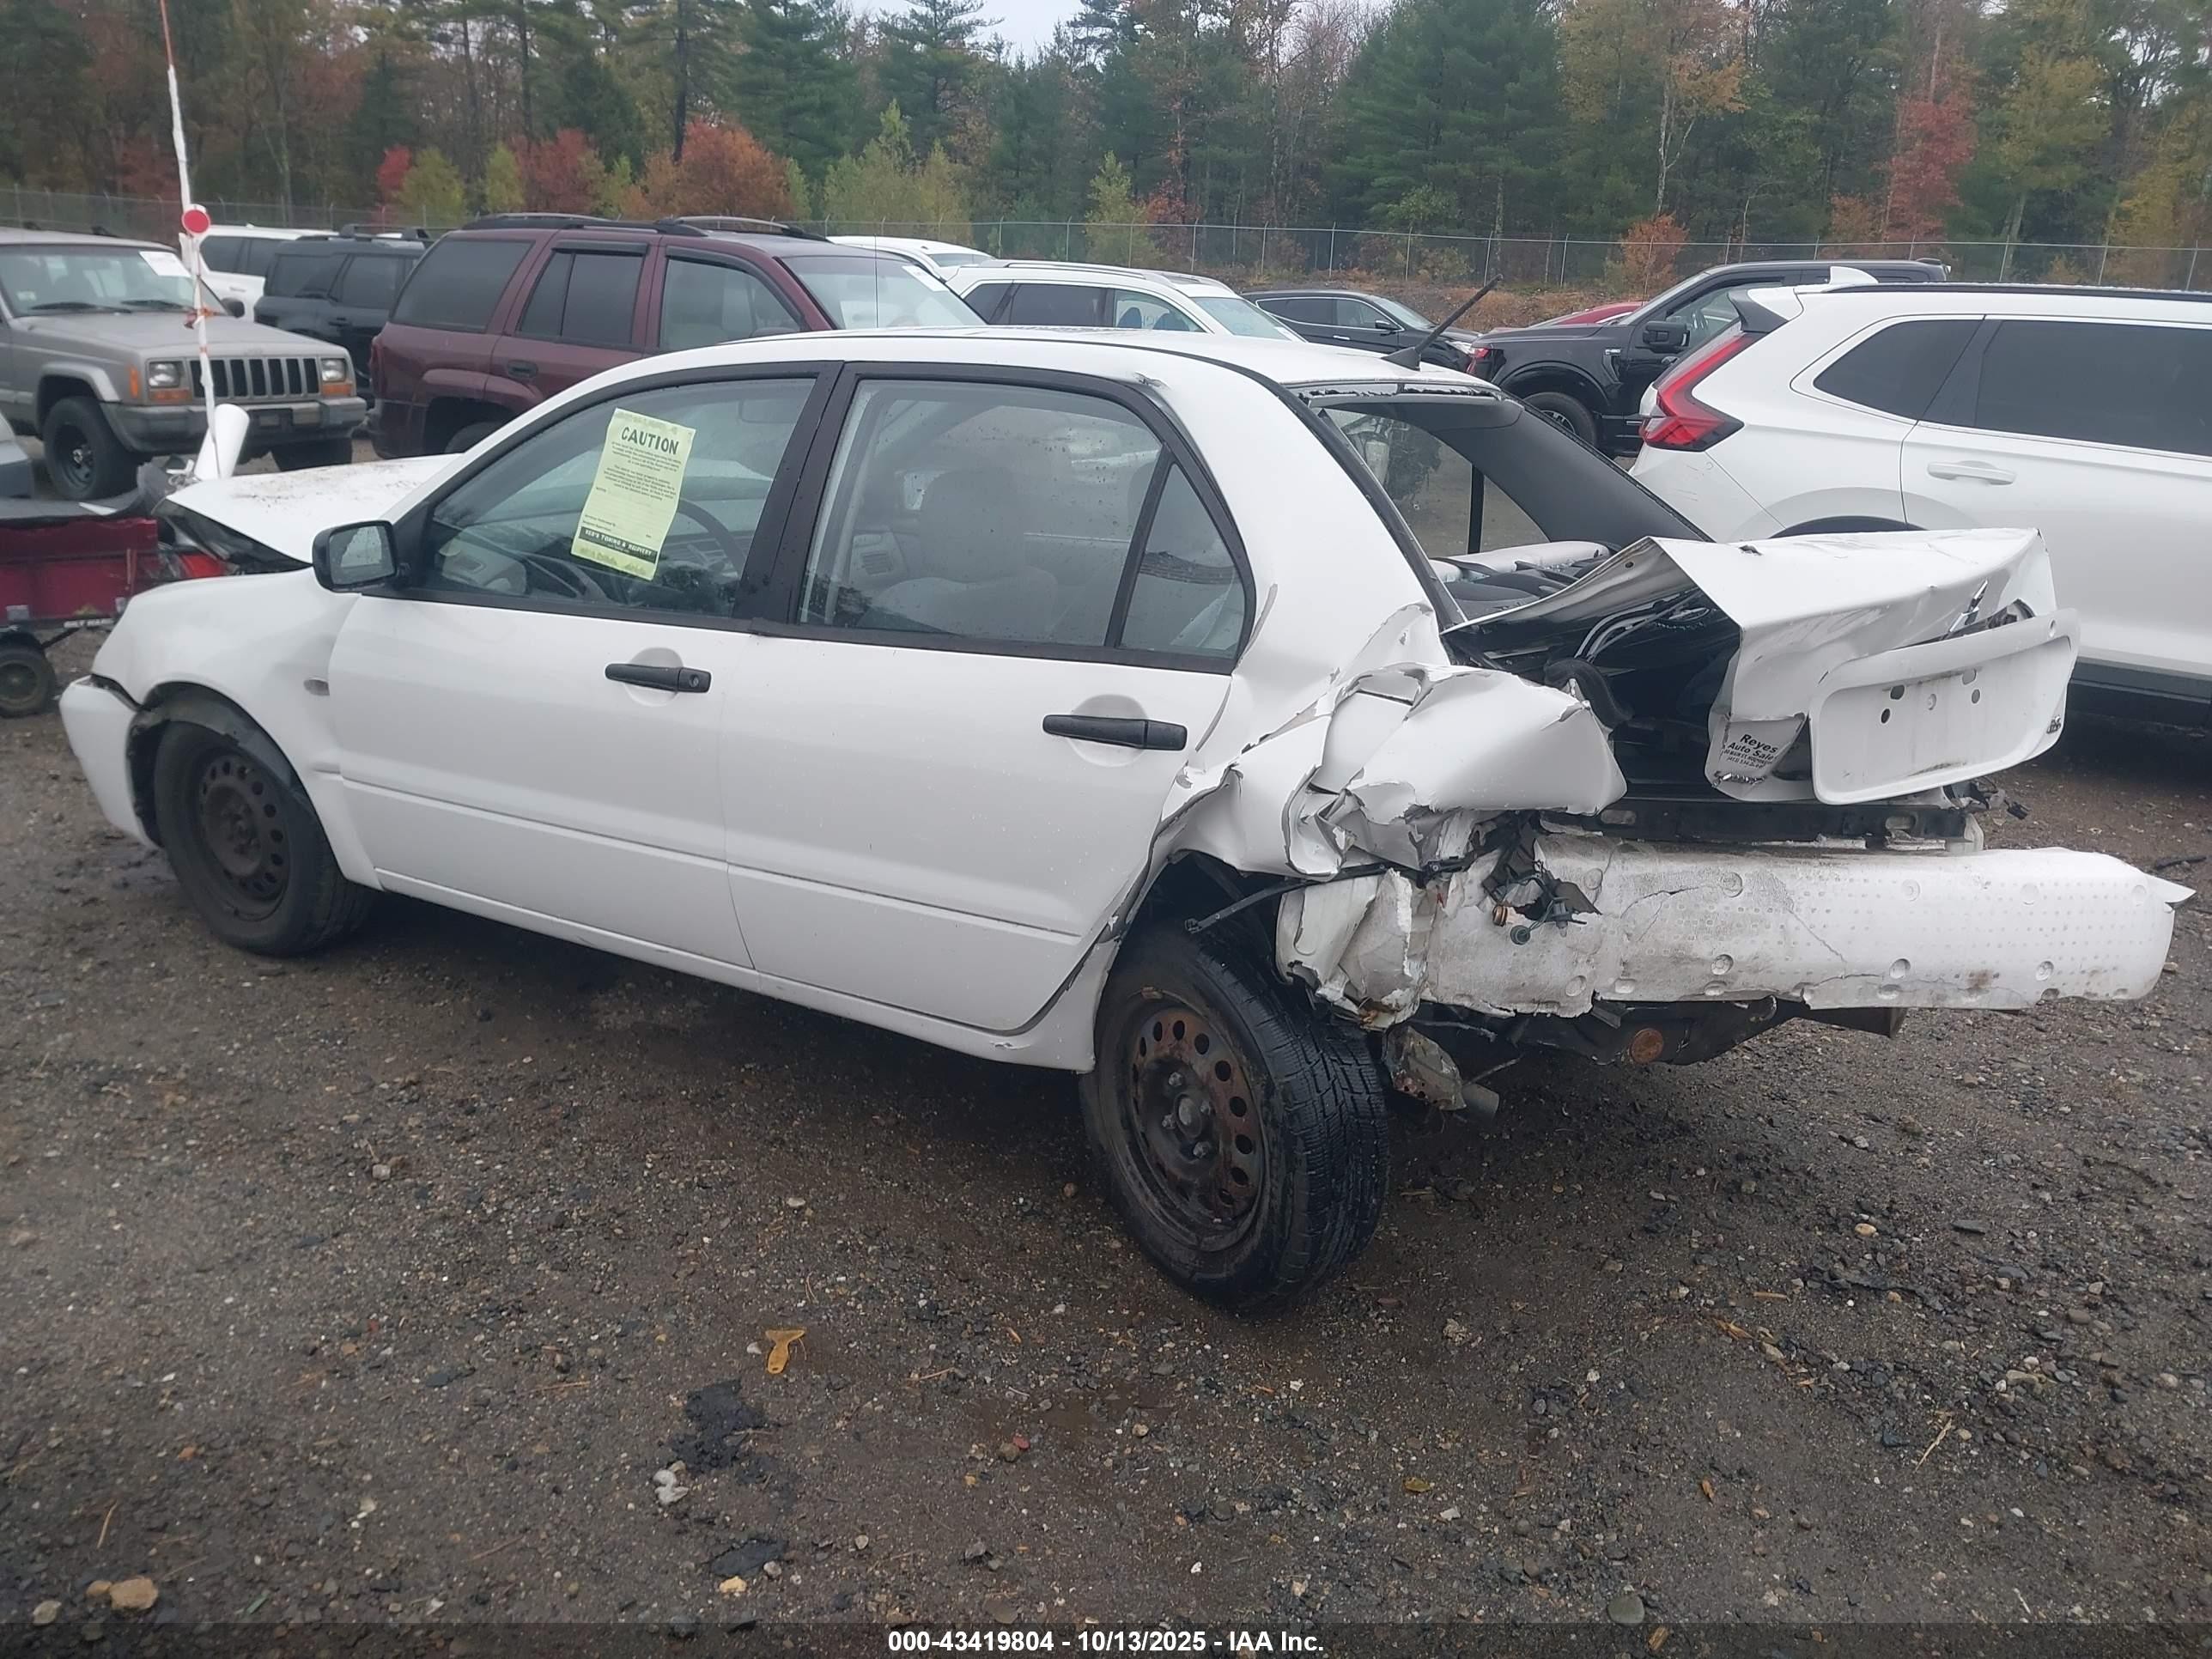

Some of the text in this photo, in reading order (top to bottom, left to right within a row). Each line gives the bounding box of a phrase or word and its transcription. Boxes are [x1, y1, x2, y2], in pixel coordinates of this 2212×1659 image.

[621, 426, 679, 455] CAUTION
[1728, 742, 1751, 754] Auto
[1740, 733, 1778, 754] Reyes
